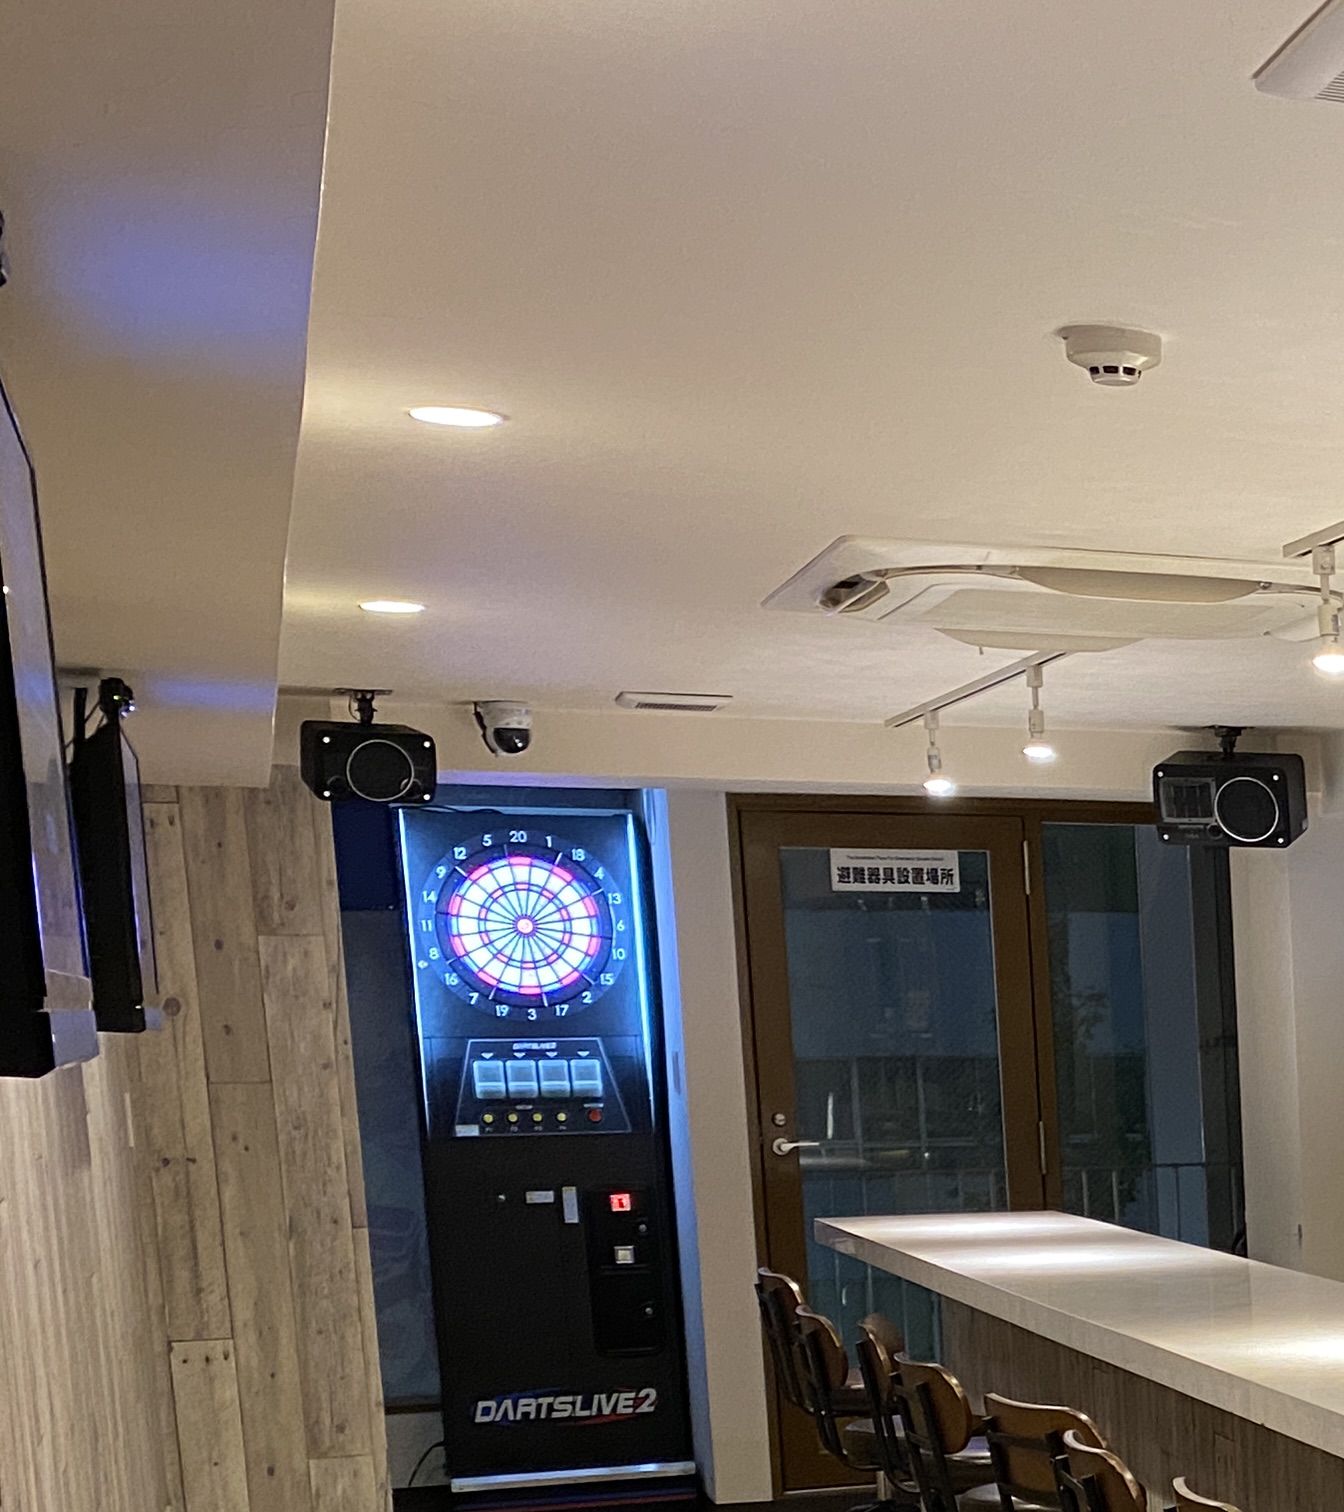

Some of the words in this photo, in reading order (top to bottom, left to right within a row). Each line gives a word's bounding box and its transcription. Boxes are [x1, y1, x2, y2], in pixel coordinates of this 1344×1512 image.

[482, 833, 493, 846] 5
[509, 831, 528, 843] 20
[545, 835, 553, 848] 1
[453, 846, 467, 860] 12
[571, 847, 585, 861] 18
[436, 866, 447, 879] 9
[594, 866, 605, 879] 4
[837, 866, 954, 885] 避難器具設置場所
[421, 890, 436, 903] 14
[608, 893, 622, 904] 13
[421, 919, 432, 931] 11
[616, 921, 625, 932] 6
[429, 947, 440, 960] 8
[612, 948, 626, 960] 10
[444, 973, 459, 986] 16
[600, 973, 615, 986] 15
[469, 992, 479, 1005] 7
[581, 991, 592, 1004] 2
[495, 1004, 510, 1018] 19
[527, 1009, 538, 1021] 3
[555, 1004, 569, 1017] 17
[474, 1387, 657, 1424] DARTSLIVE2
